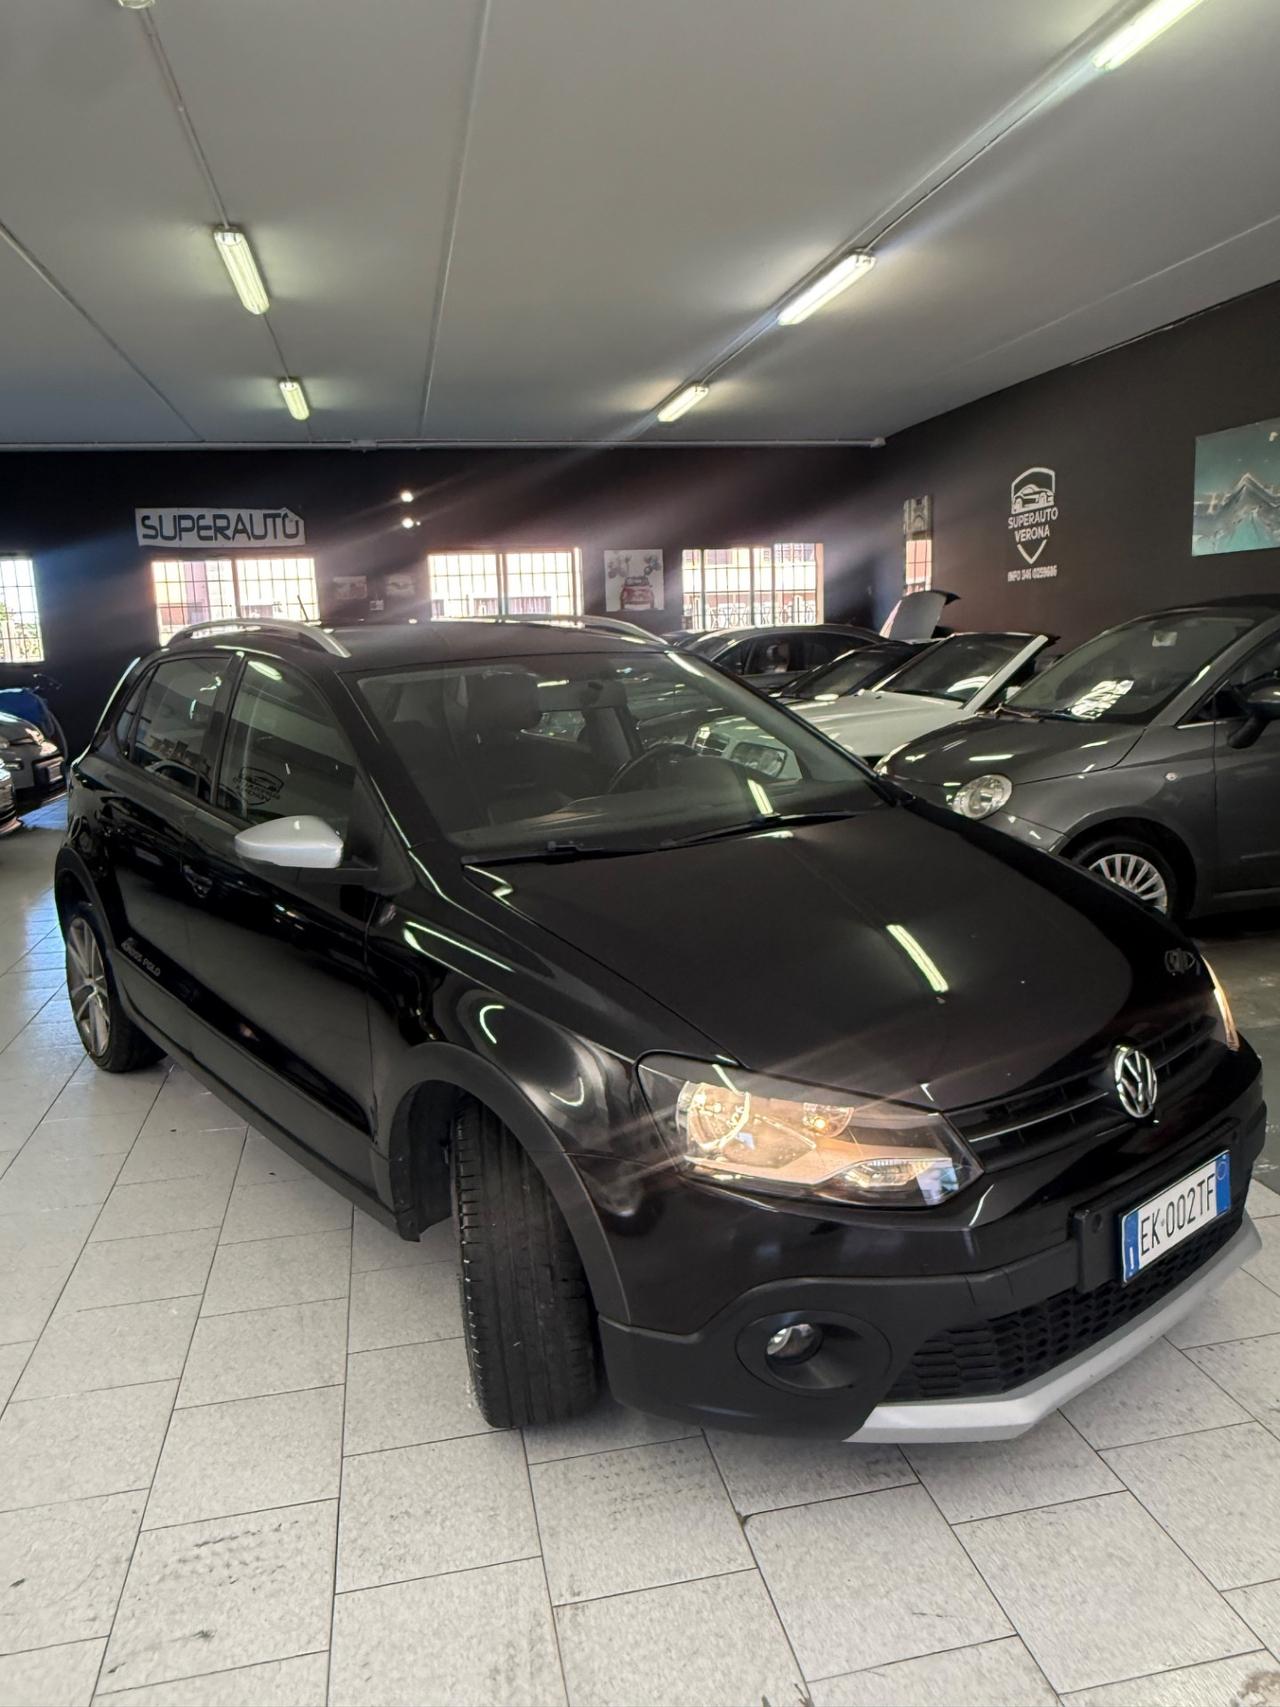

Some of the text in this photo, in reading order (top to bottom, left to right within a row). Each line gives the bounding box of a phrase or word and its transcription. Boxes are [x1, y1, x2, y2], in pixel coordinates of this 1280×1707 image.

[141, 512, 299, 541] SUPERAUTO
[1007, 507, 1058, 529] SUPERAUTO
[1014, 524, 1050, 542] VERONA
